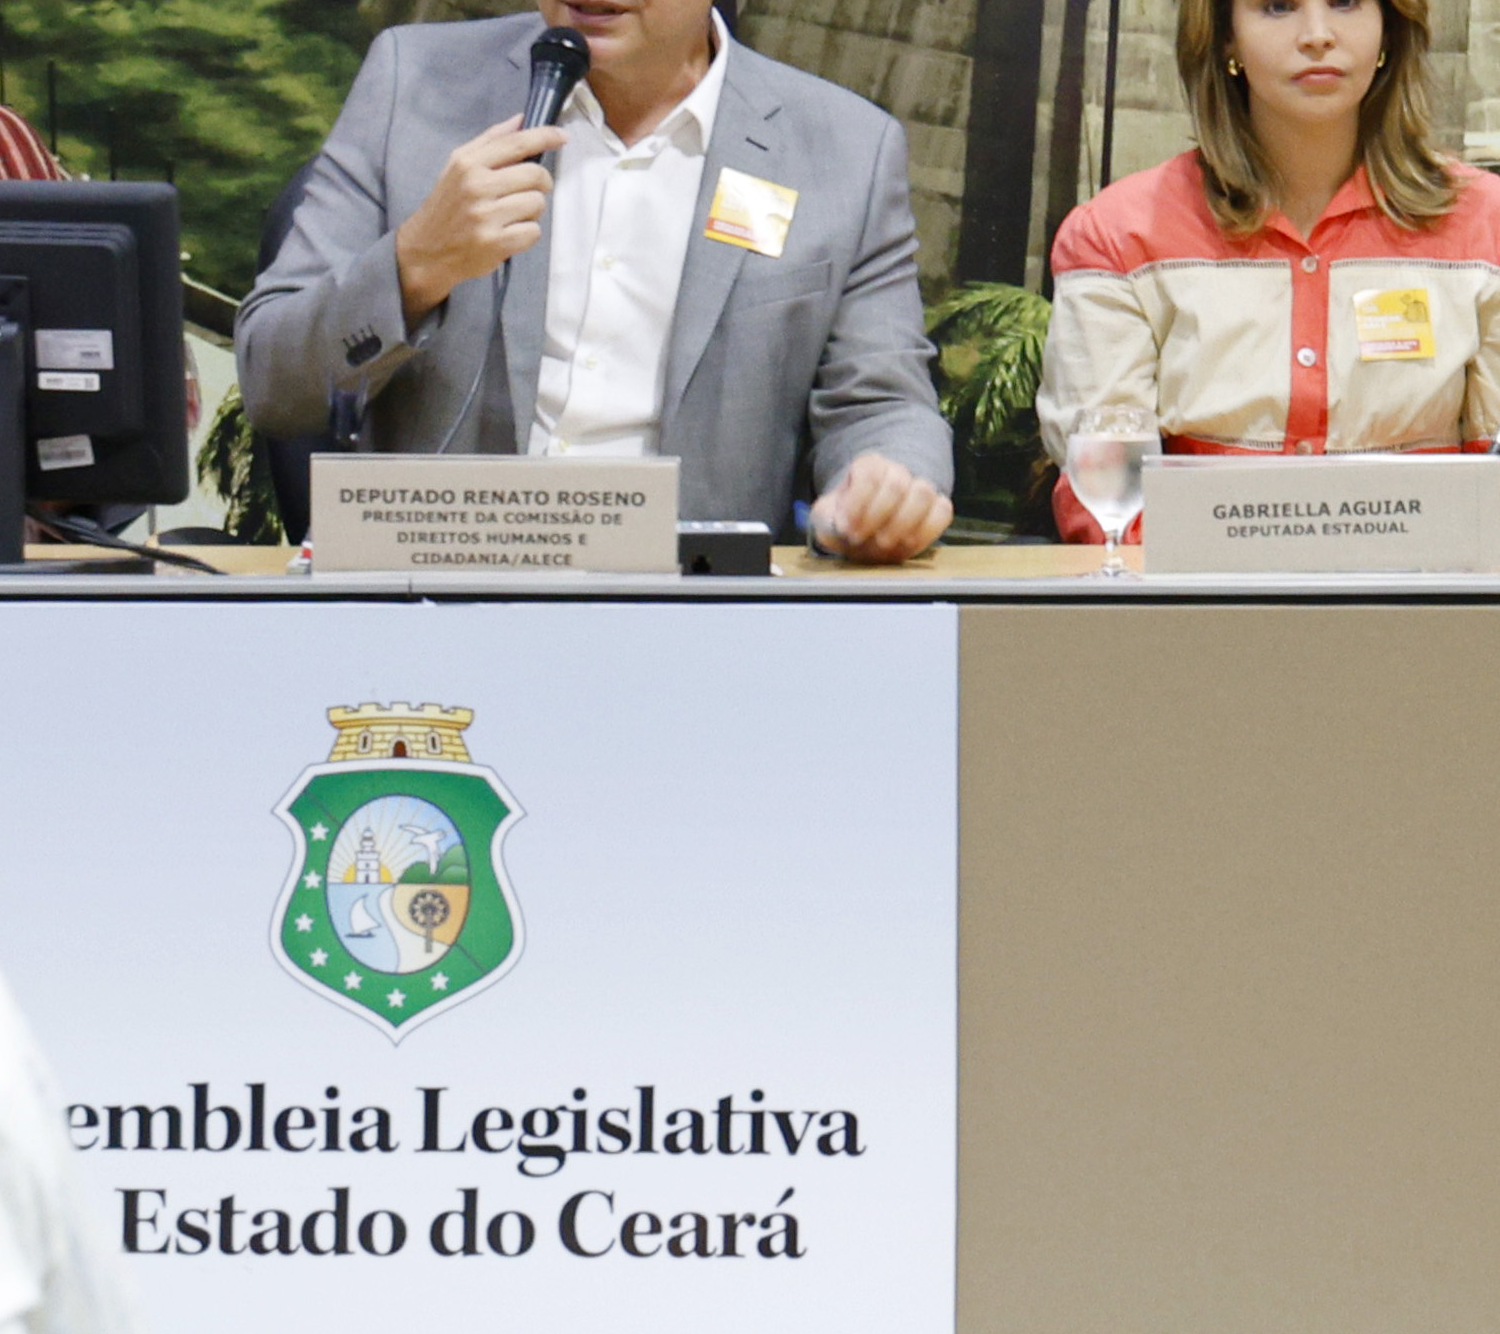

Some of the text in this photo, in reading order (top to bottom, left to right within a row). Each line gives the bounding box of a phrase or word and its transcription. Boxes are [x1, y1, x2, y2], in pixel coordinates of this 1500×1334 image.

[339, 488, 646, 507] DEPUTADO RENATO ROSENO
[362, 507, 623, 525] PRESIDENTE DA COMISSÃO DE
[1212, 498, 1422, 520] GABRIELLA AGUIAR
[396, 531, 587, 545] DIREITOS HUMANOS E
[1226, 520, 1409, 538] DEPUTADA ESTADUAL
[411, 551, 573, 567] CIDADANIA/ALECE
[62, 1082, 866, 1179] embleia Legislativa
[112, 1185, 807, 1260] Estado do Ceará
